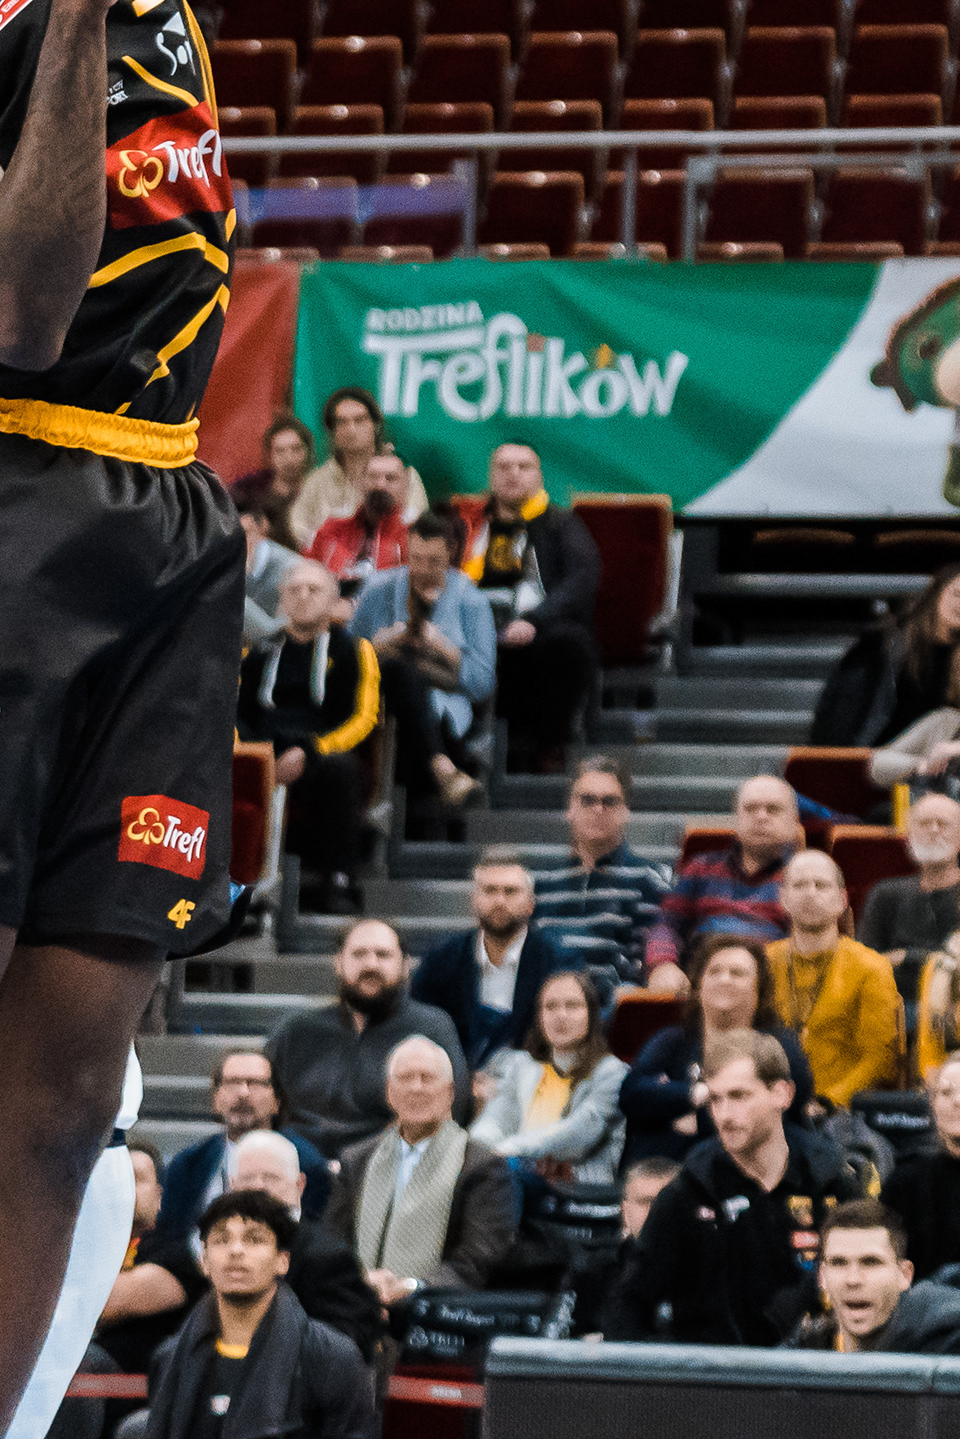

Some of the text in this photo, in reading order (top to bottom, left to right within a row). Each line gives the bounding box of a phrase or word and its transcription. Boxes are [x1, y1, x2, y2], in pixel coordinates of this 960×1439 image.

[151, 129, 222, 189] Trefl
[367, 300, 484, 332] RODZINA
[163, 815, 206, 863] Trefl
[168, 898, 196, 930] 4F
